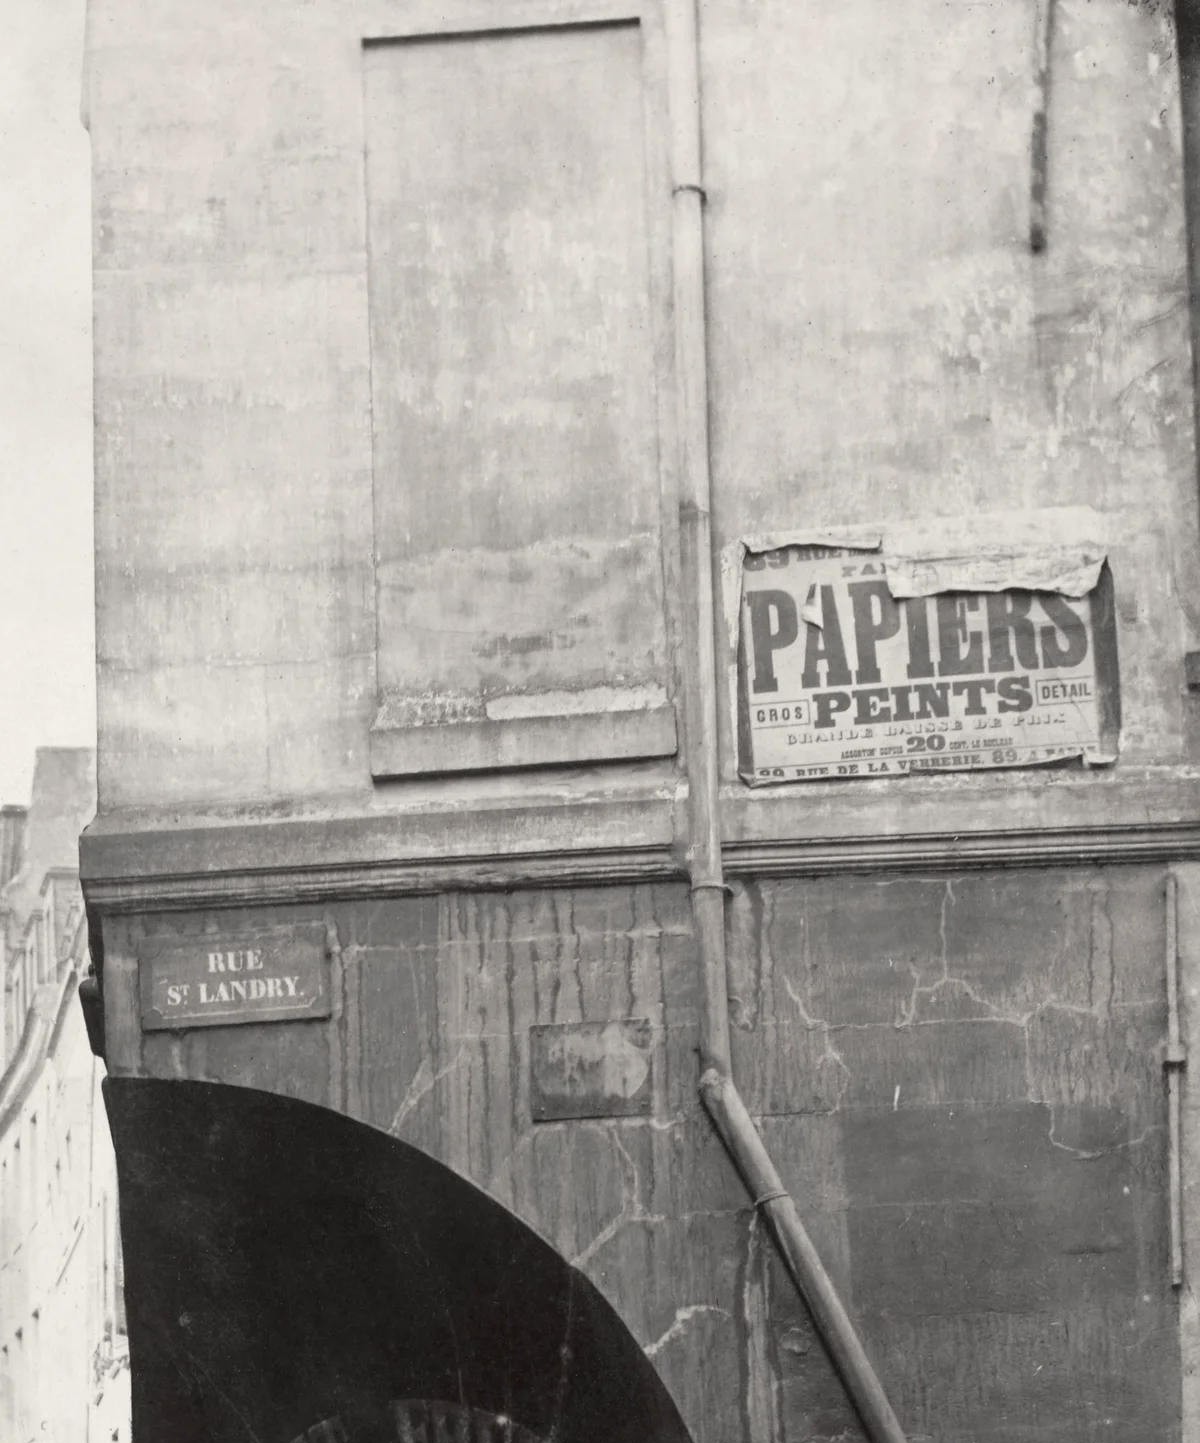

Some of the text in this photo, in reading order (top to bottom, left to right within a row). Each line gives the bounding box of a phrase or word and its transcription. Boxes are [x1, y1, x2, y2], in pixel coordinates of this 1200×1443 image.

[746, 580, 1088, 694] PAPIERS
[1042, 684, 1091, 699] DETAIL
[814, 676, 1033, 728] PEINTS
[756, 706, 803, 723] GROS
[906, 734, 946, 752] 20
[837, 763, 860, 774] DE
[868, 762, 891, 773] LA
[207, 949, 264, 973] RUE
